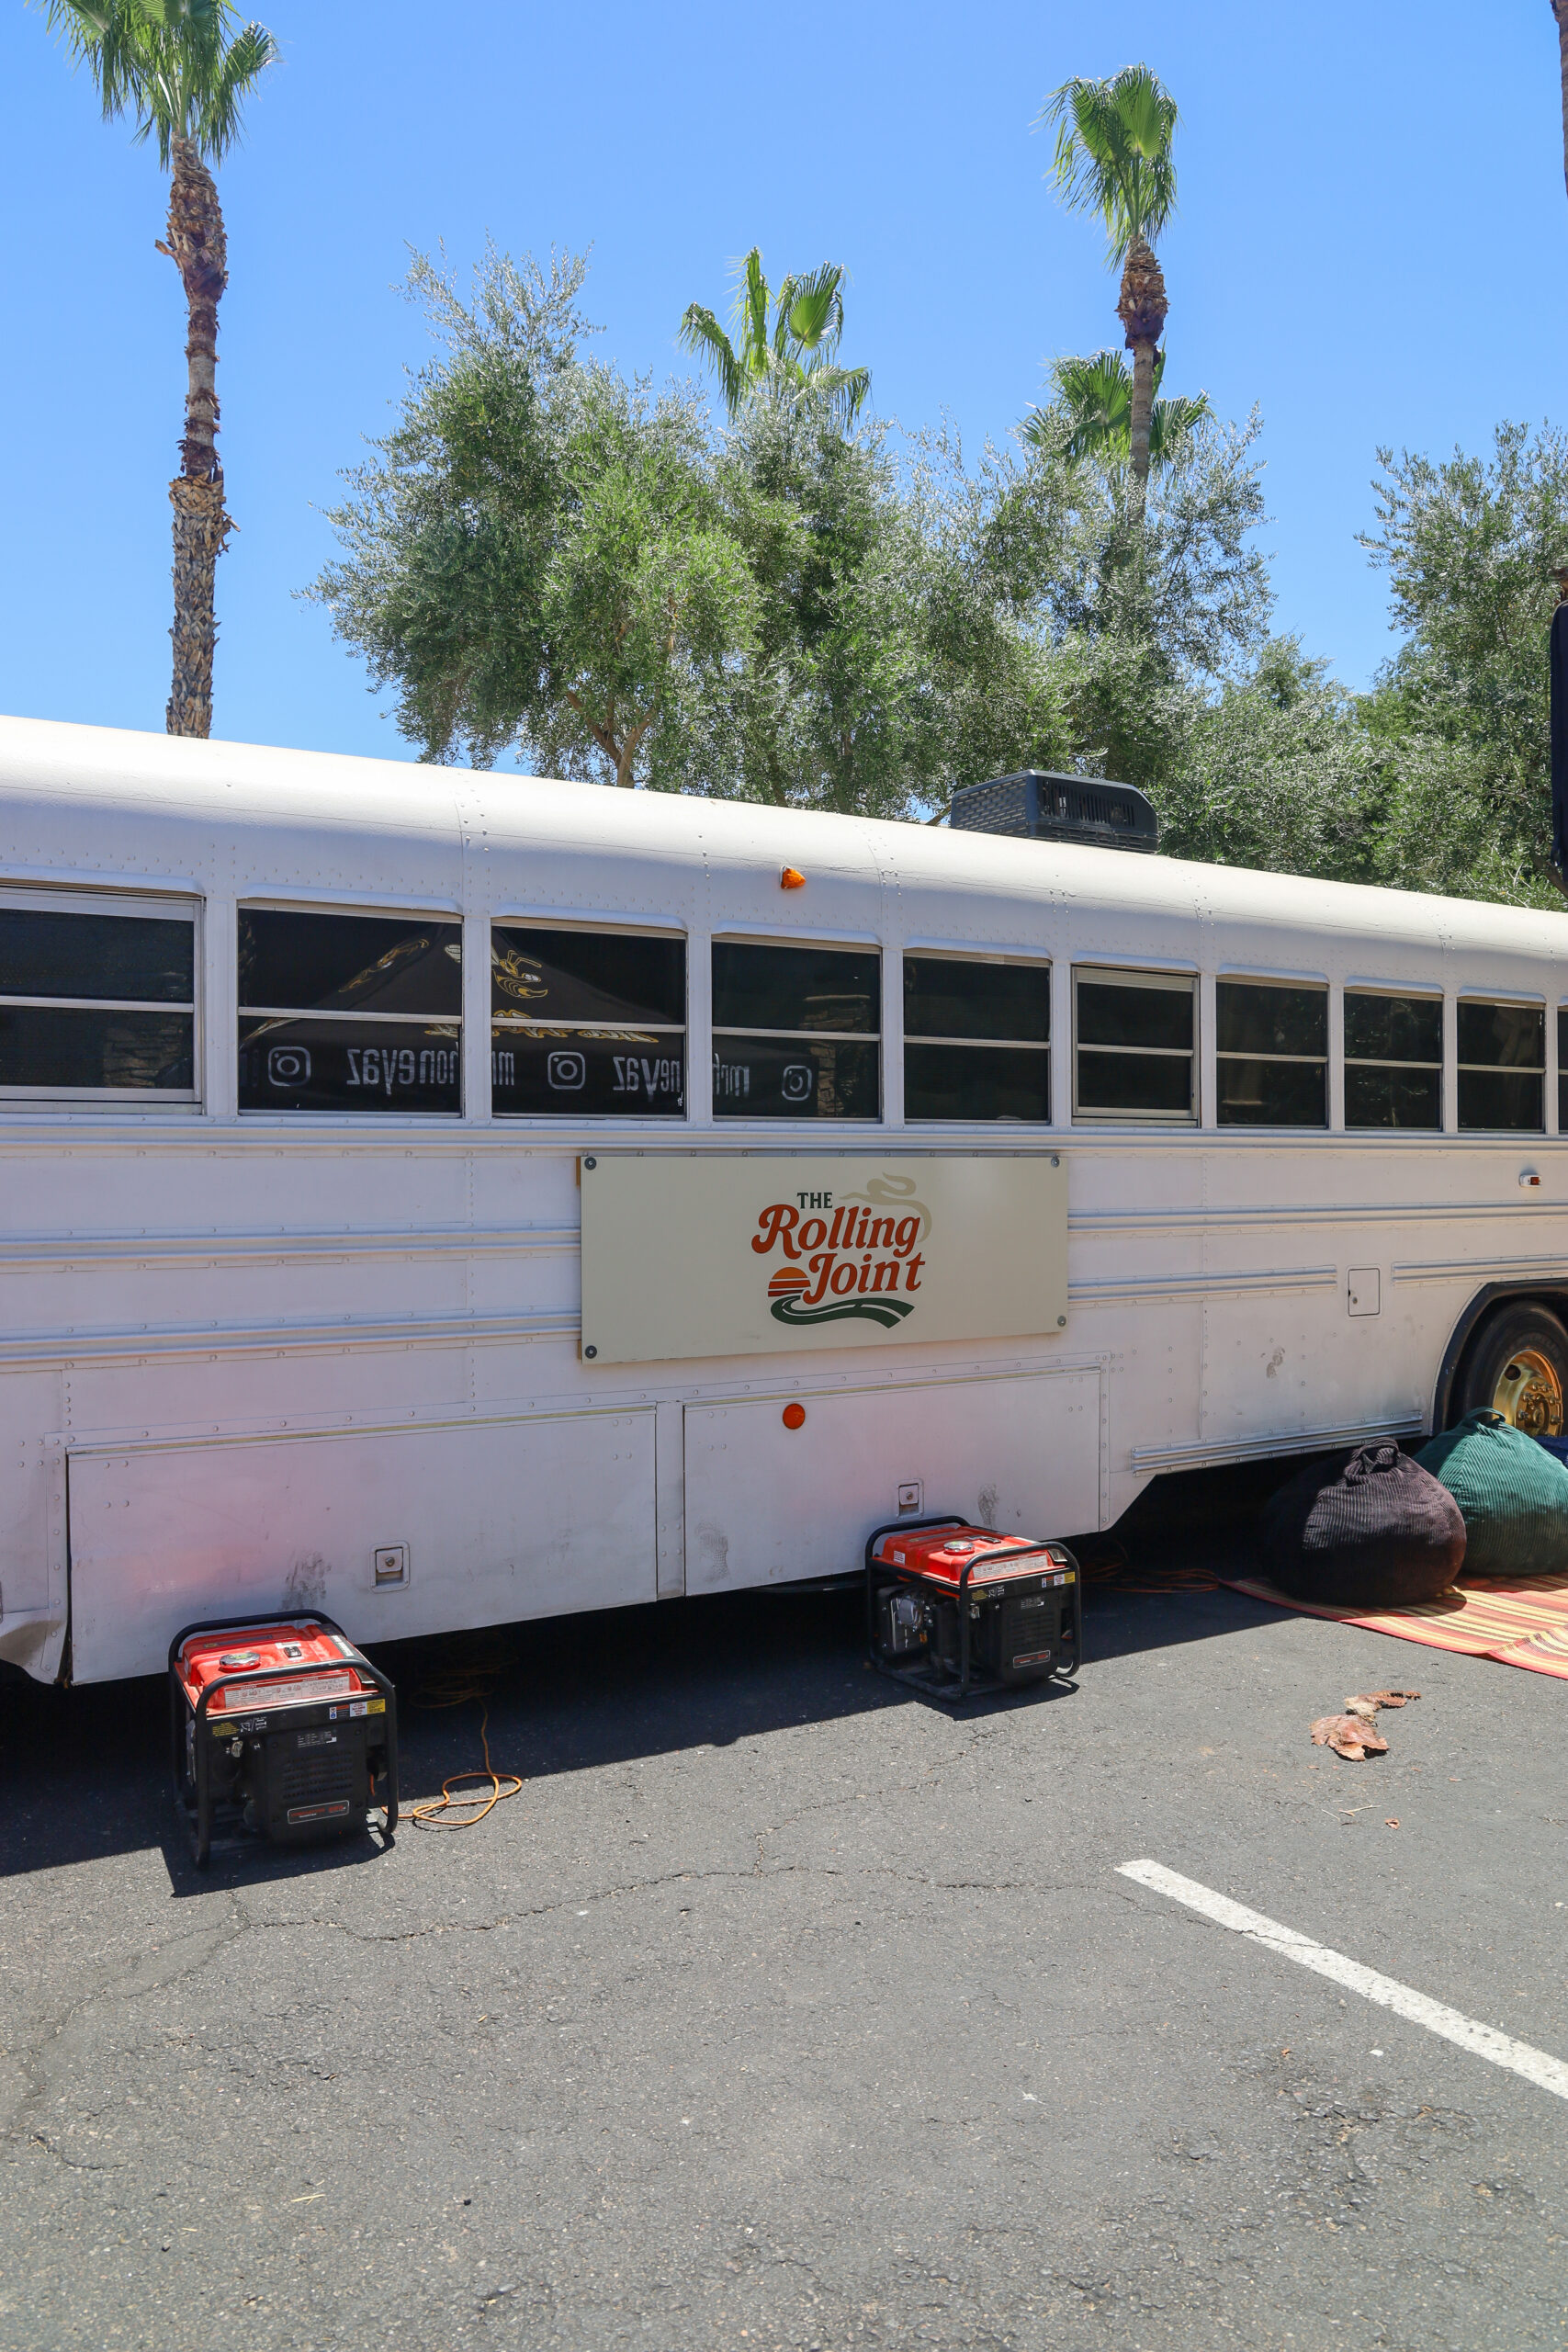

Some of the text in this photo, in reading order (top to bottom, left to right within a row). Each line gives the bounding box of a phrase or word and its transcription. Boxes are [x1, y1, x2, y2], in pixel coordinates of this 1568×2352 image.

[796, 1192, 833, 1209] THE
[751, 1204, 920, 1260] Rolling
[803, 1252, 926, 1305] Joint
